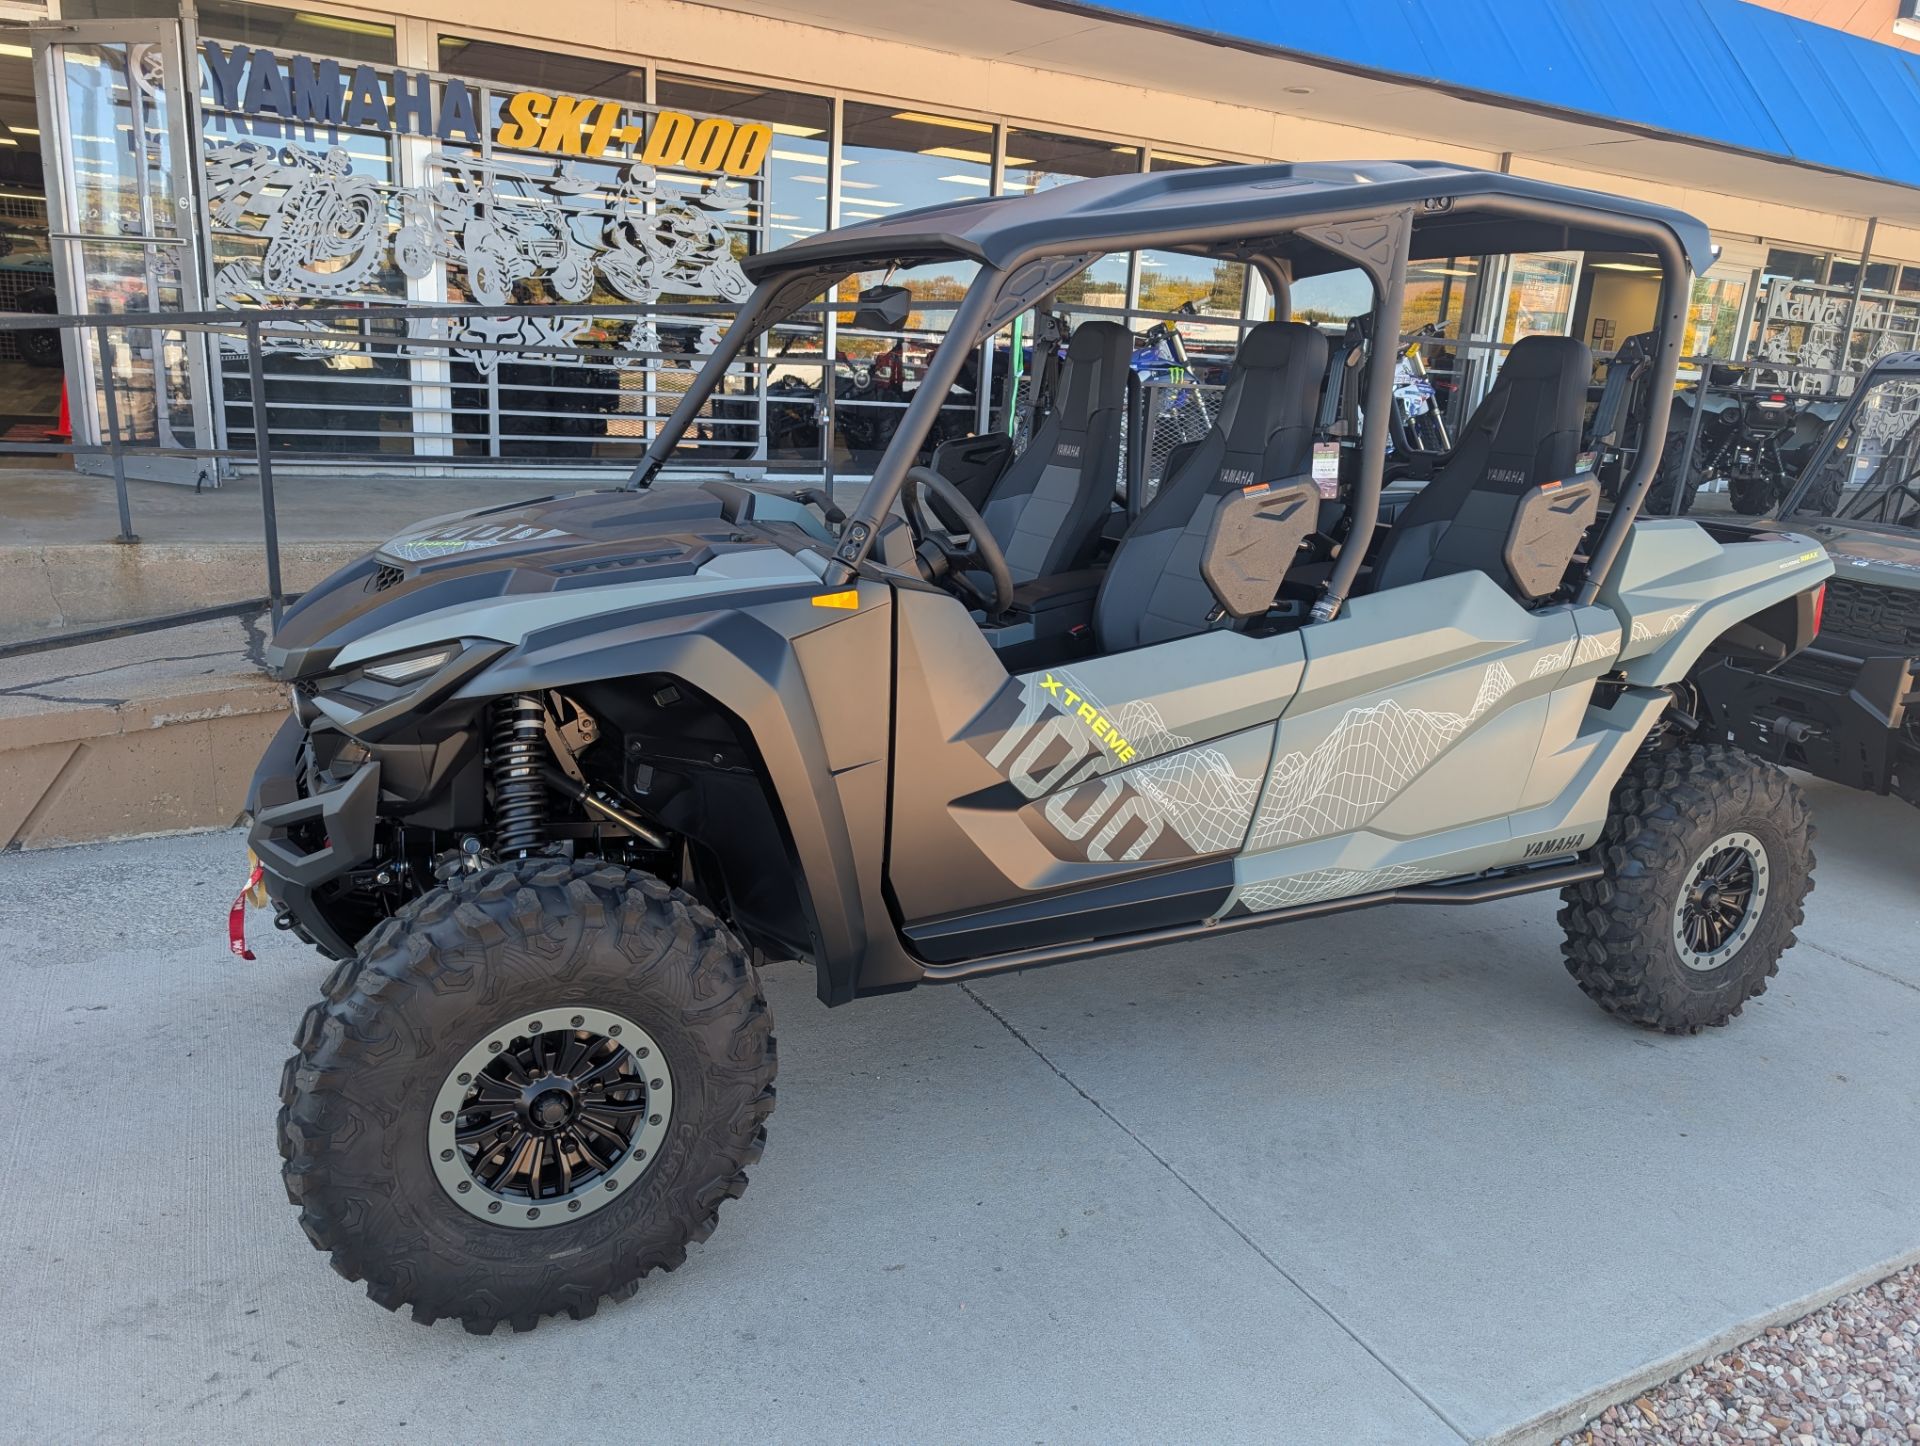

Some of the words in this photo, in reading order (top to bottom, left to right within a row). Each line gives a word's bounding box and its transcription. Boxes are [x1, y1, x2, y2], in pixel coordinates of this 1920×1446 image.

[202, 40, 482, 144] YAMAHA
[497, 91, 773, 177] SKI-DOO
[1219, 468, 1255, 486] YAMAHA
[1487, 468, 1527, 485] YAMAHA
[1039, 673, 1137, 764] XTREME
[985, 675, 1166, 862] 1000
[1136, 769, 1181, 816] TERRAIN
[1523, 833, 1585, 858] YAMAHA
